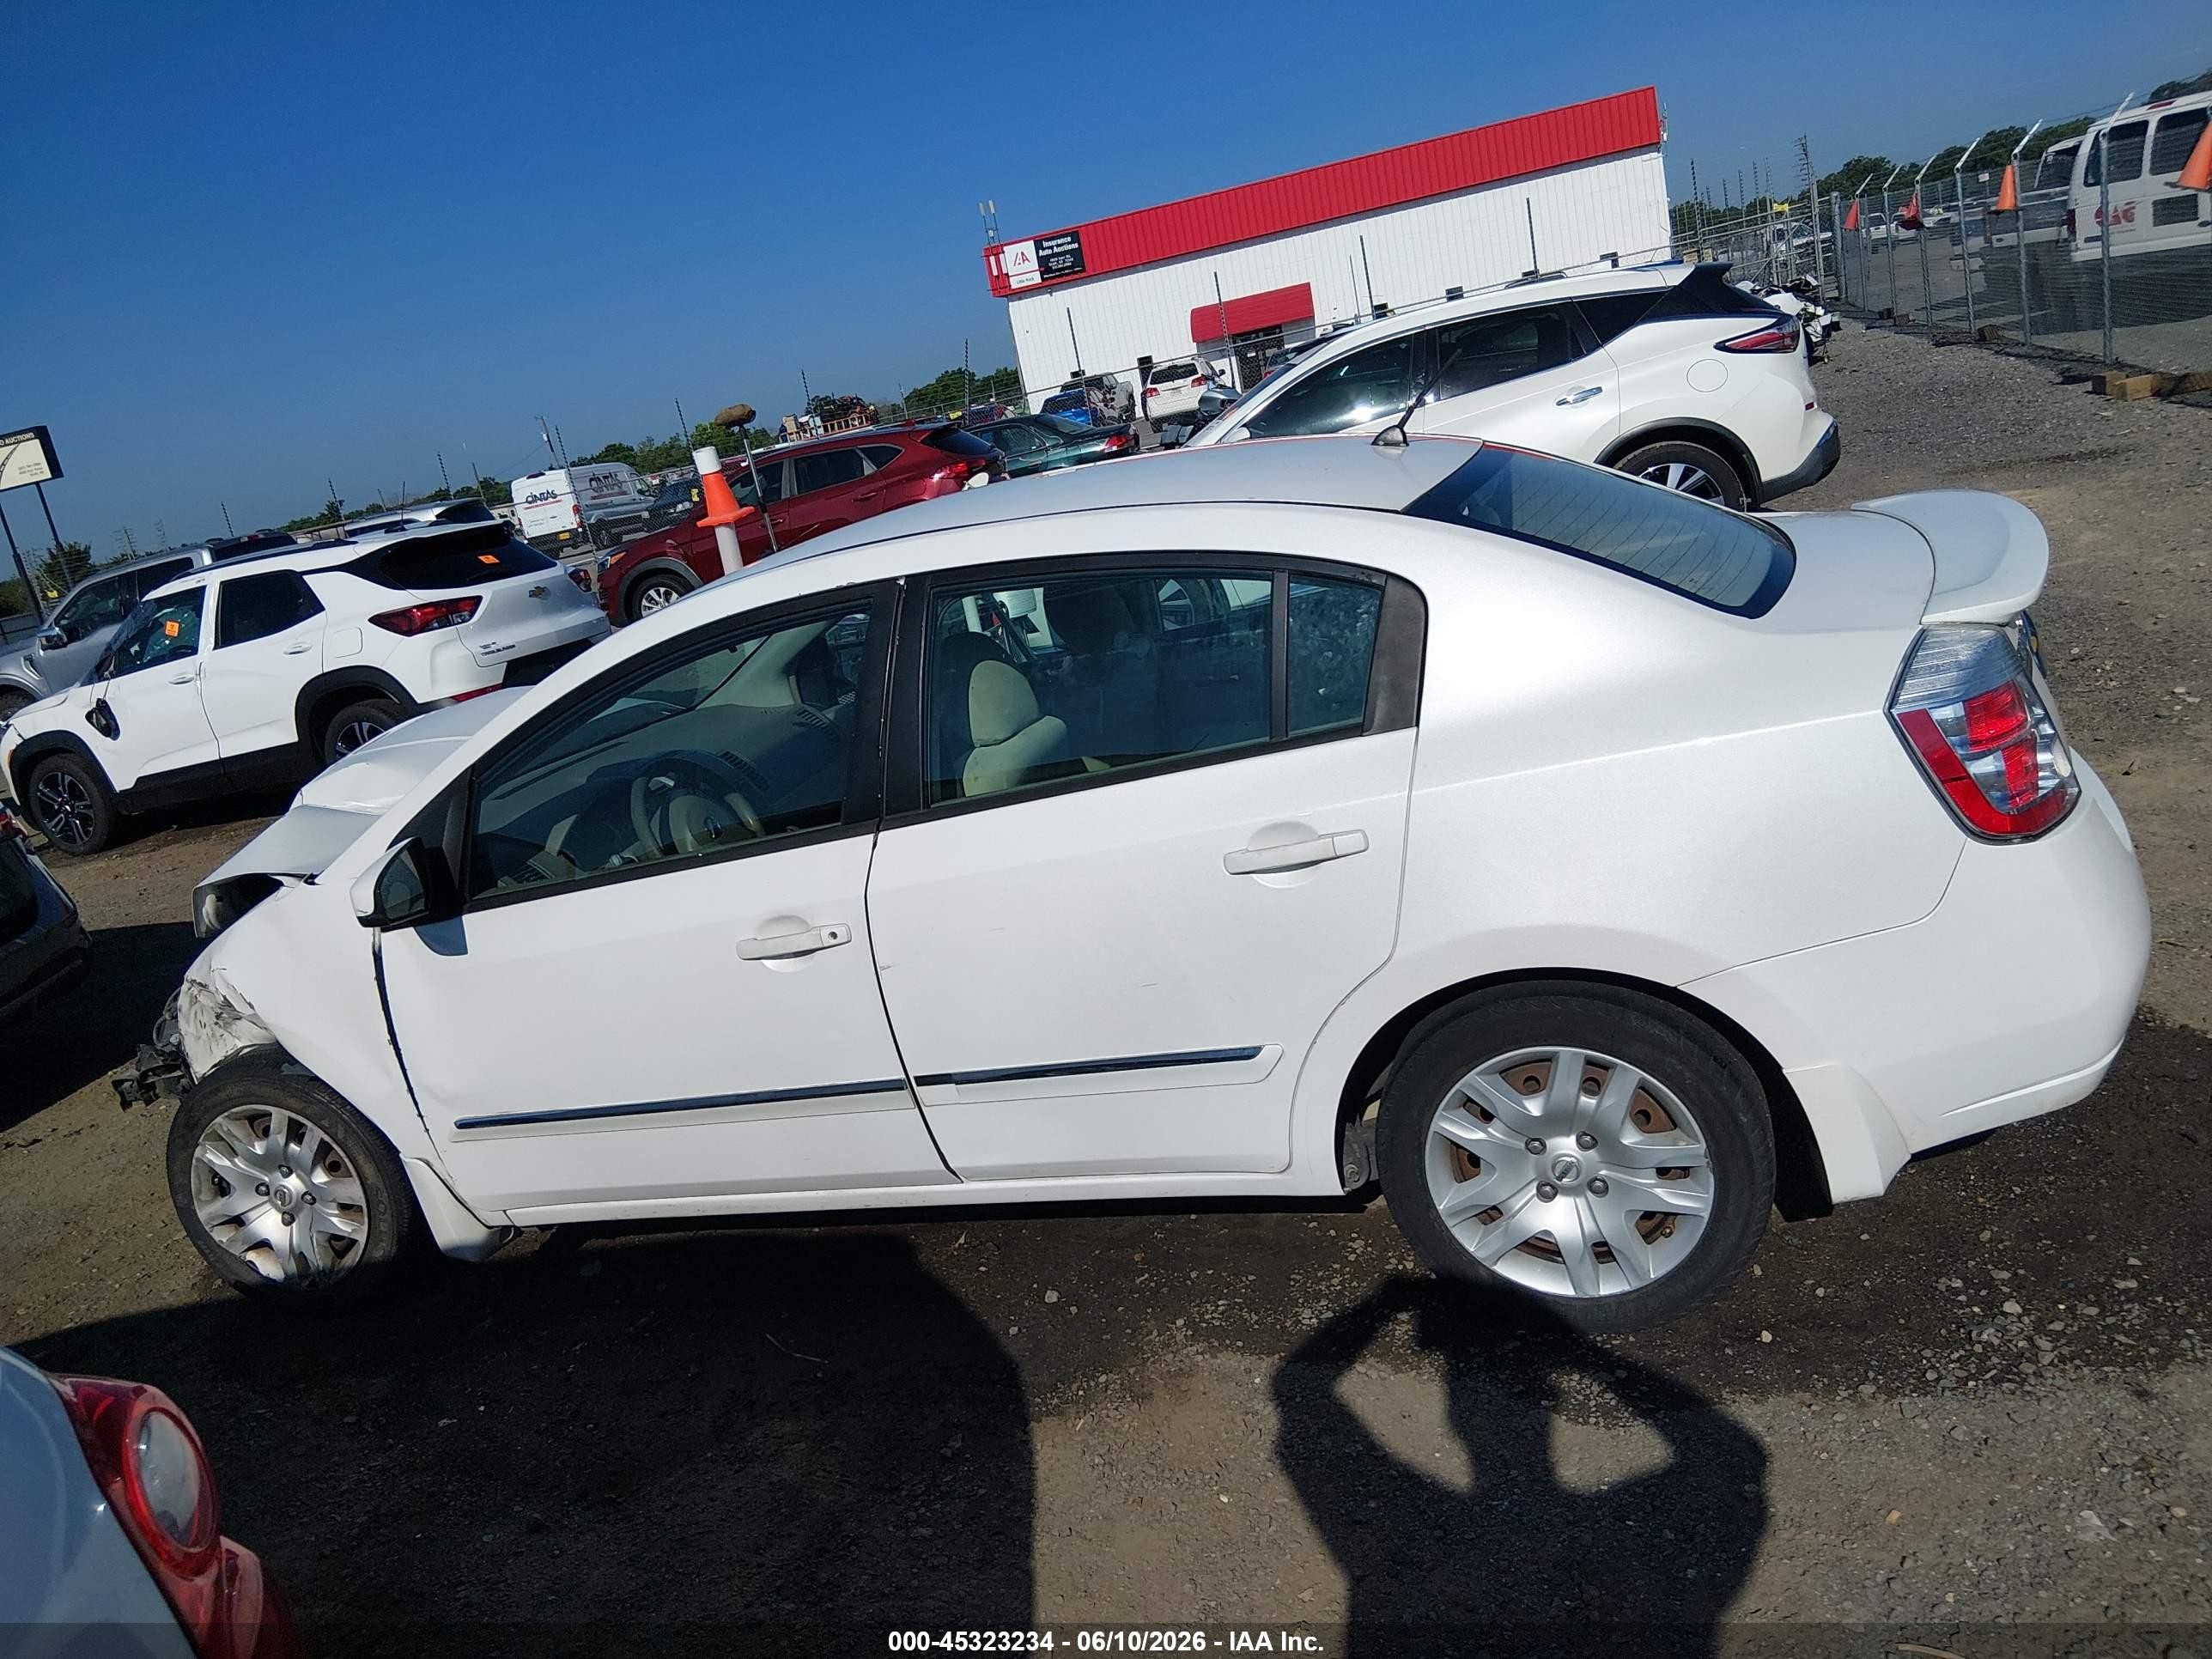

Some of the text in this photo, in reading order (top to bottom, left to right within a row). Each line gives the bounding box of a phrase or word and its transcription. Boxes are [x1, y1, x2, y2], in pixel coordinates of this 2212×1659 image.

[1042, 236, 1072, 248] Insurance
[1039, 242, 1079, 258] Auto Auctions
[5, 432, 35, 445] AUCTIONS
[526, 489, 558, 505] CINTAS
